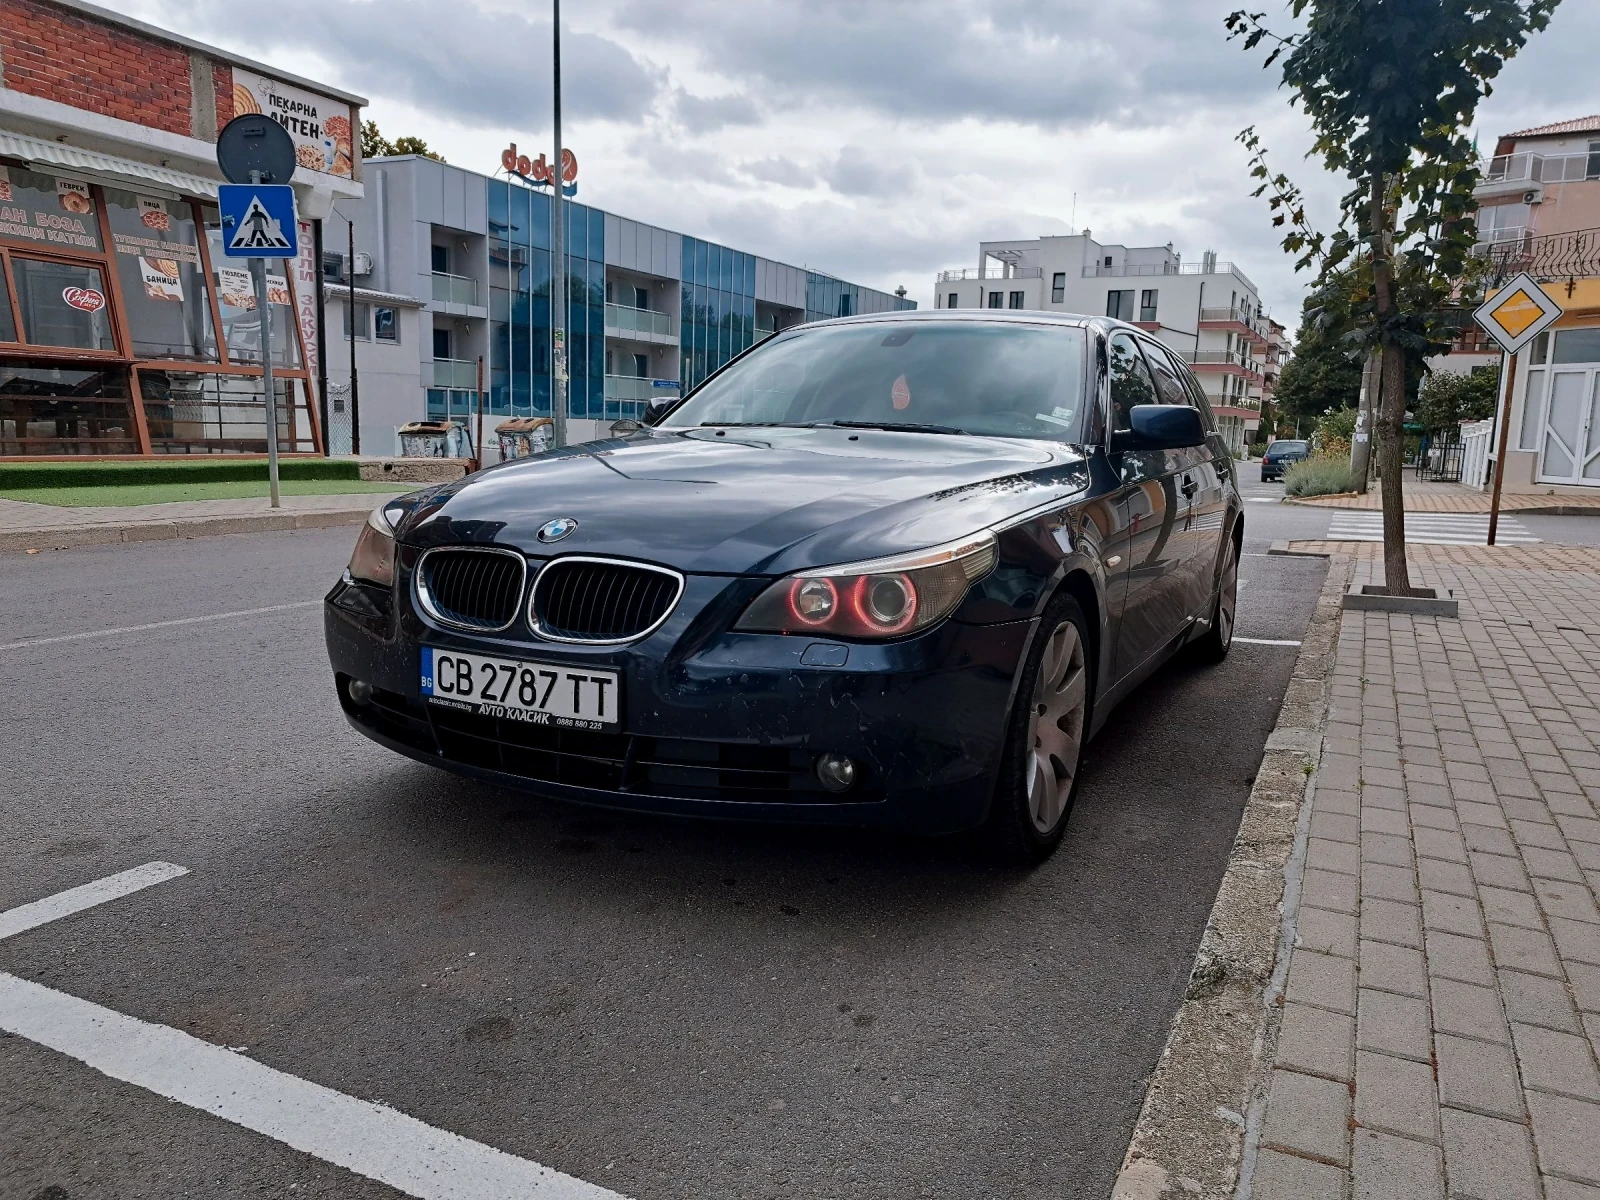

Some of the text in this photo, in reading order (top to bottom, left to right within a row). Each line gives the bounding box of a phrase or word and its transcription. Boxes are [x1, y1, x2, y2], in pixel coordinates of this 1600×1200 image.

[268, 93, 318, 119] ПЕКАРНА
[60, 182, 85, 192] ГЕВРЕК
[143, 200, 160, 209] ПИЦА
[35, 211, 86, 234] БОЗА
[47, 229, 97, 248] КАТМИ
[298, 221, 314, 283] ТОПЛИ
[146, 275, 178, 286] БАНИЦА
[67, 287, 100, 306] София
[421, 676, 432, 688] BG
[437, 655, 612, 717] CB 2787 TT
[478, 702, 550, 725] АУТО КЛАСИК
[588, 721, 603, 730] 225
